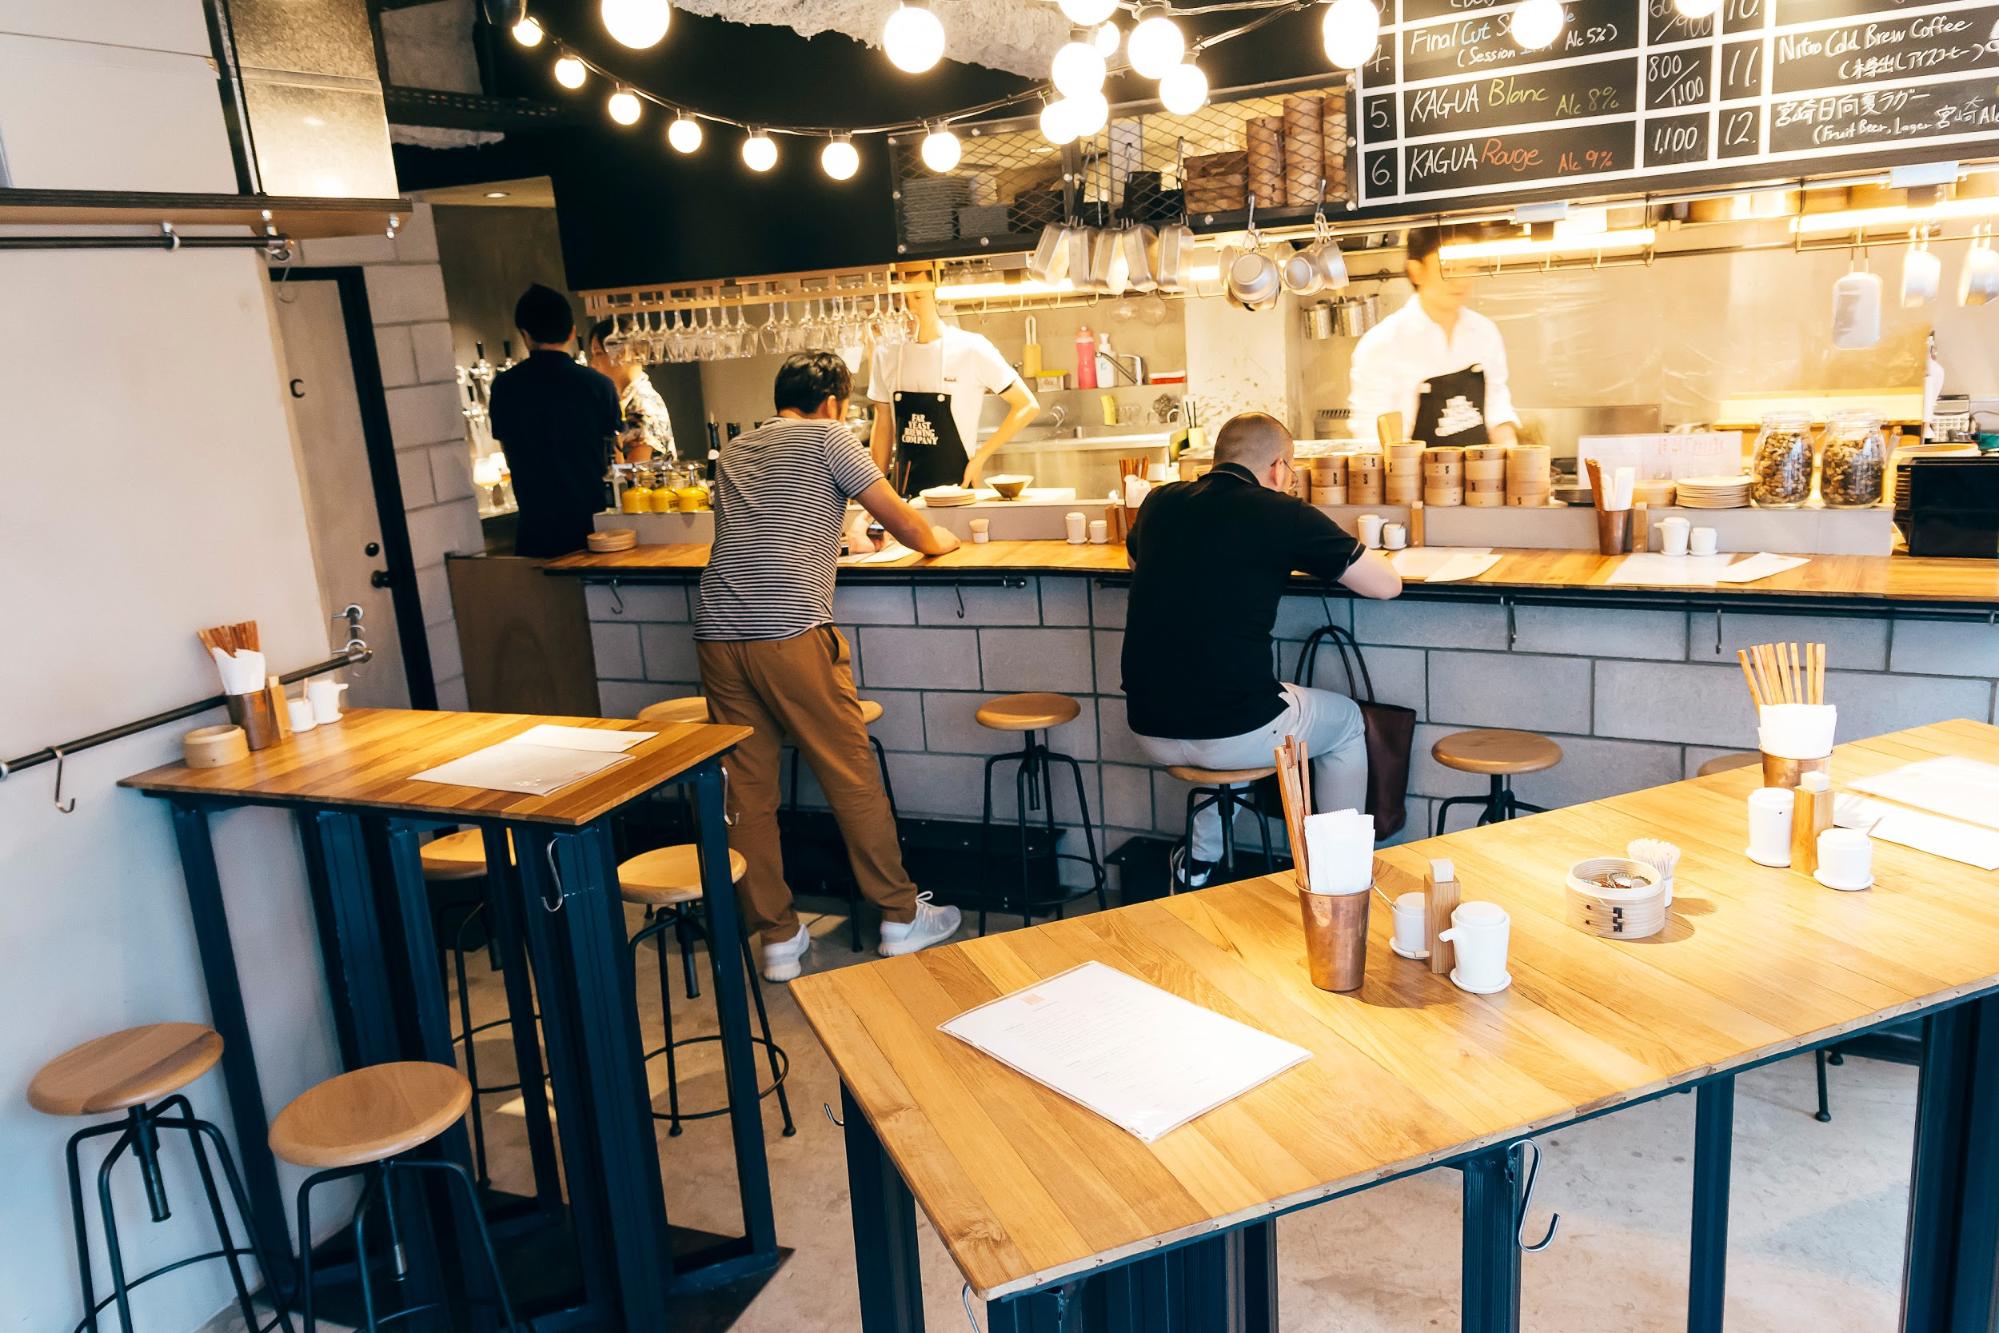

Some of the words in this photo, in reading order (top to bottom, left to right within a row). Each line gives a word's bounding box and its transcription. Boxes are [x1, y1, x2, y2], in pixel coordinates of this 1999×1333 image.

[1410, 22, 1460, 54] Final
[1461, 21, 1491, 46] Cut
[1565, 30, 1585, 50] Alc
[1824, 30, 1861, 58] Cold
[1864, 24, 1906, 49] Brew
[1910, 15, 1974, 39] Coffee
[1410, 84, 1480, 123] KAGUA
[1488, 77, 1550, 108] Blanc
[1555, 95, 1582, 117] Alc
[1587, 86, 1620, 112] 8%
[1775, 88, 1931, 127] 宮崎日向夏ラガー
[1894, 117, 1934, 136] Lager
[1408, 143, 1478, 182] KAGUA
[1480, 138, 1544, 171] Rouge
[1557, 151, 1582, 173] Alc
[1585, 150, 1614, 170] 9%
[902, 435, 938, 445] COMPANY
